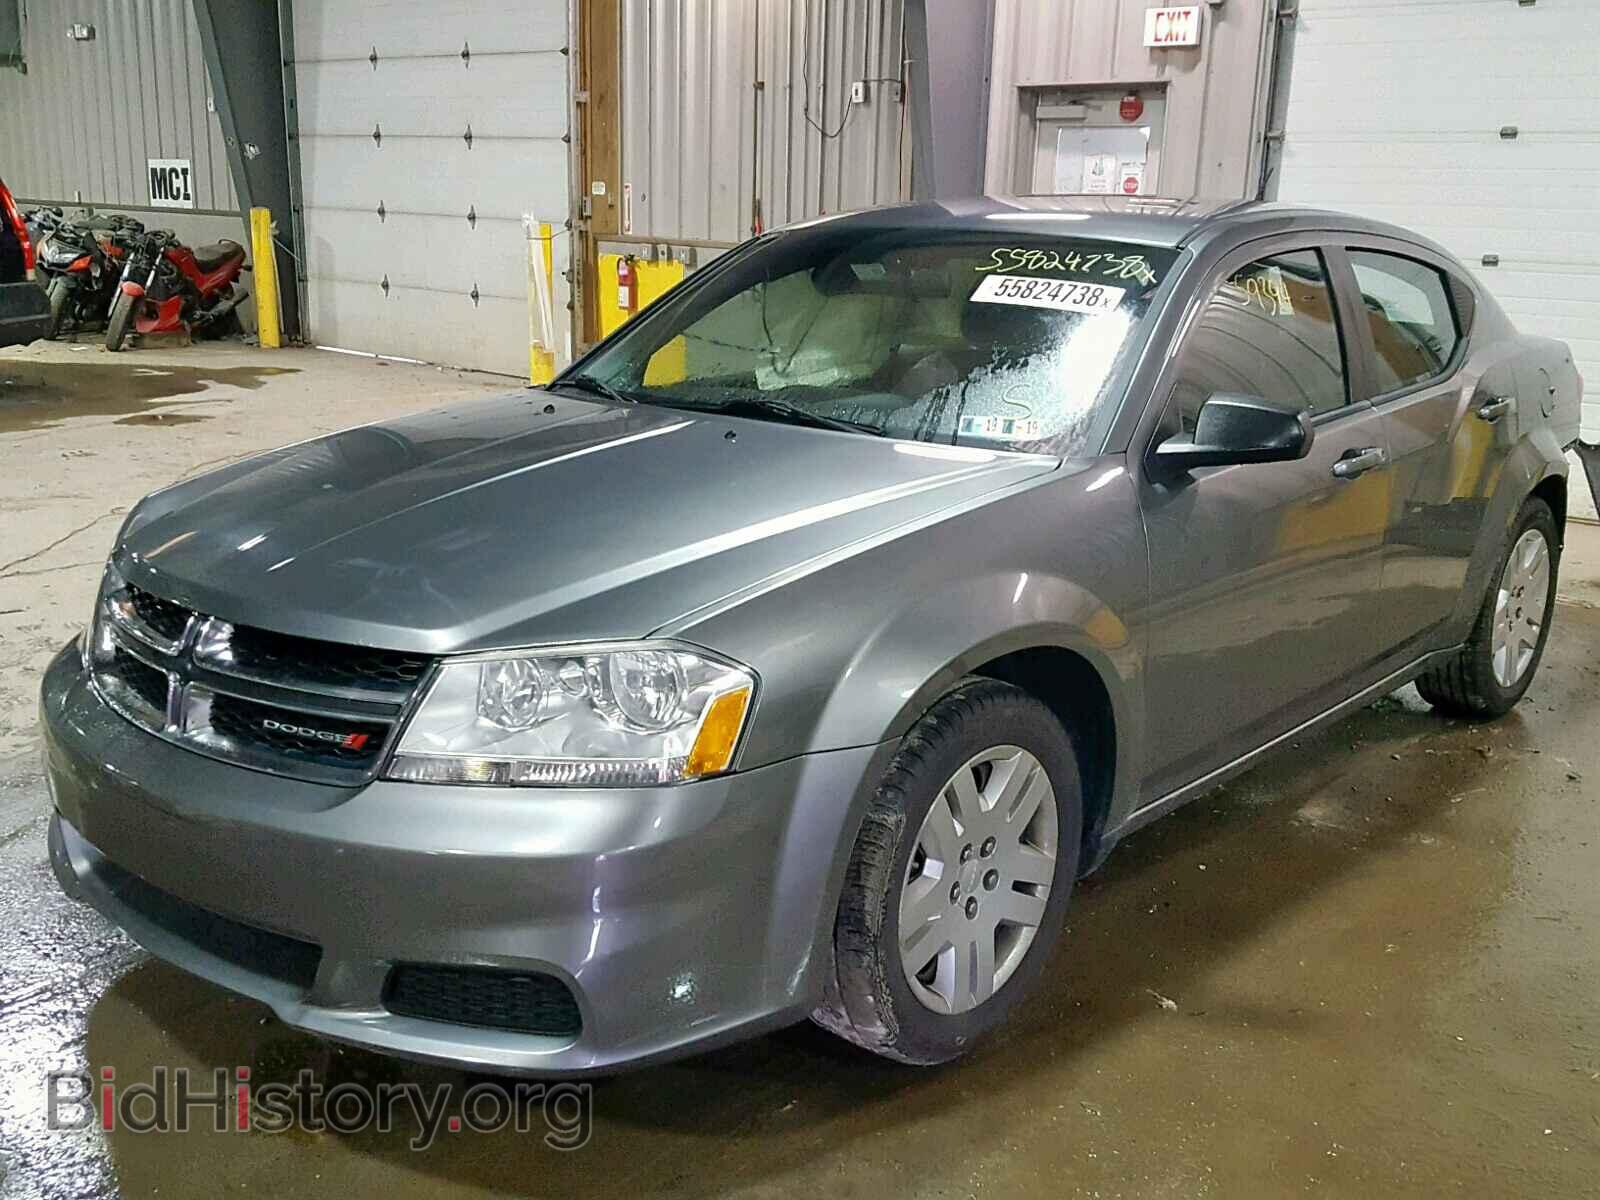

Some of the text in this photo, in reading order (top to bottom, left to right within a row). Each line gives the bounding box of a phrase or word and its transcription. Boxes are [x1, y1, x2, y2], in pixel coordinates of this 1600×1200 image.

[1153, 11, 1191, 42] EXIT
[150, 167, 191, 200] MCI
[263, 720, 352, 745] DODGE
